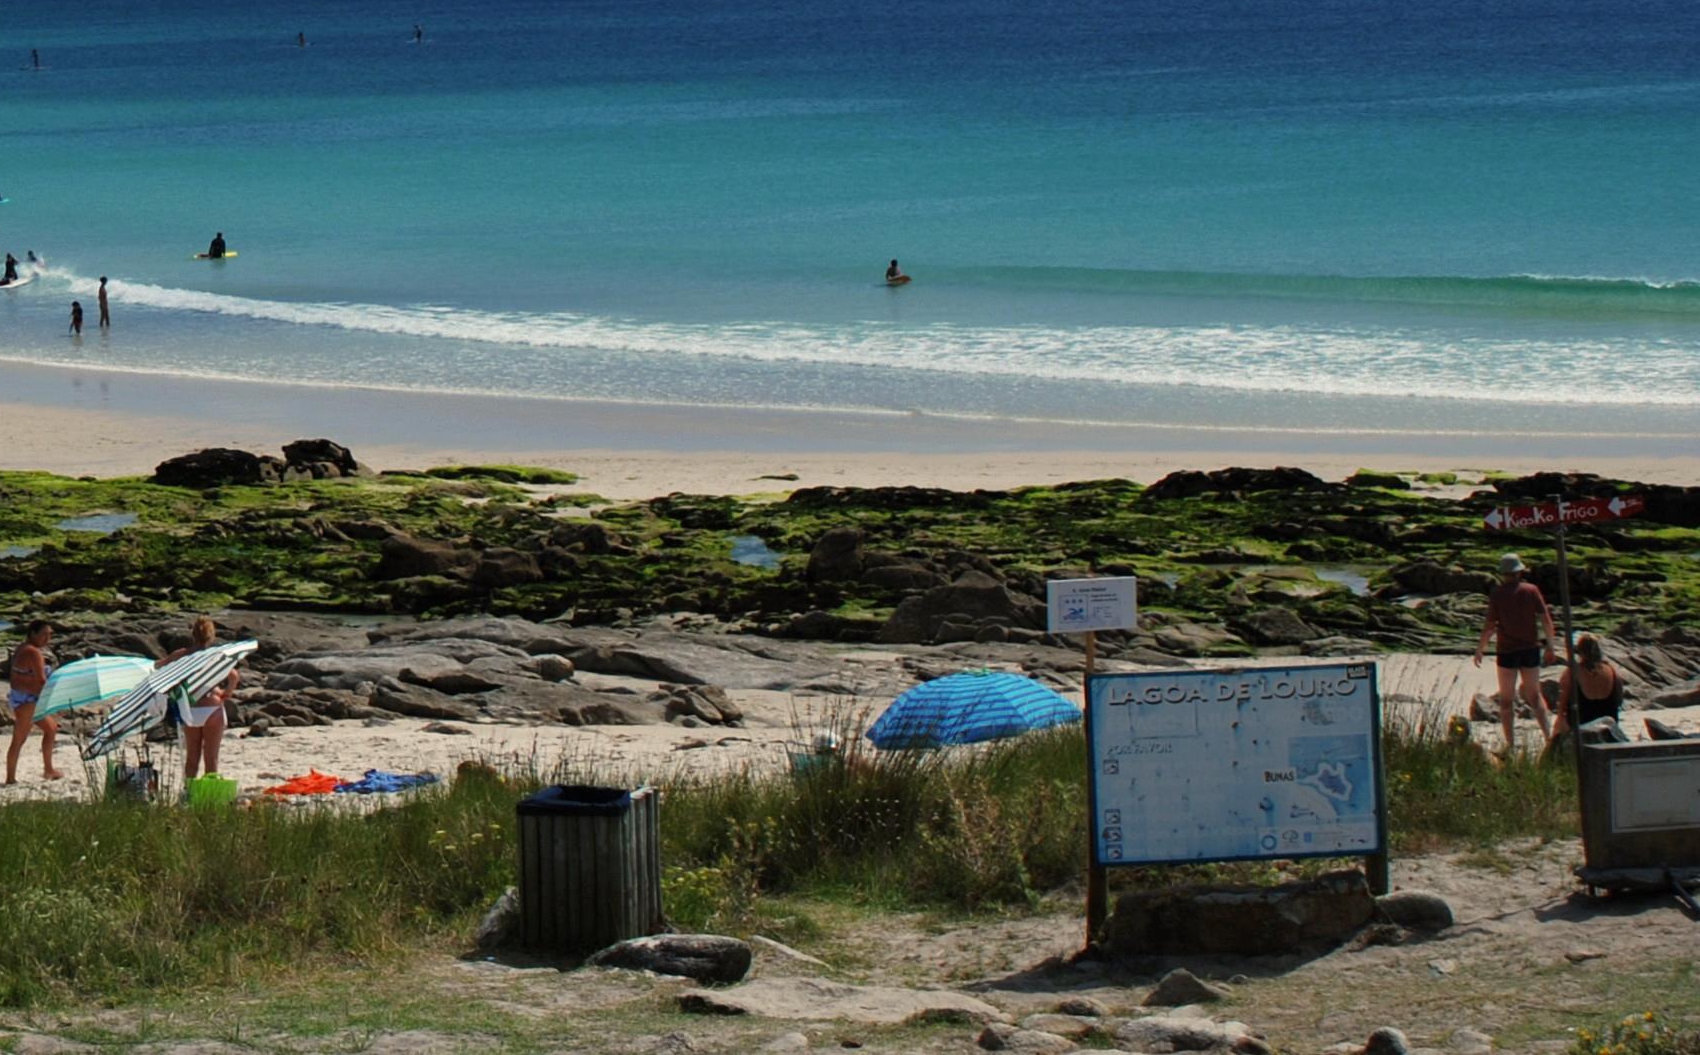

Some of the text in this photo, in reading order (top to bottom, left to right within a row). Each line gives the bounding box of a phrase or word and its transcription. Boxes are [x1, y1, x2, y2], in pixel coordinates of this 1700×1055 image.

[1108, 679, 1357, 706] LAGOA DE LOURO
